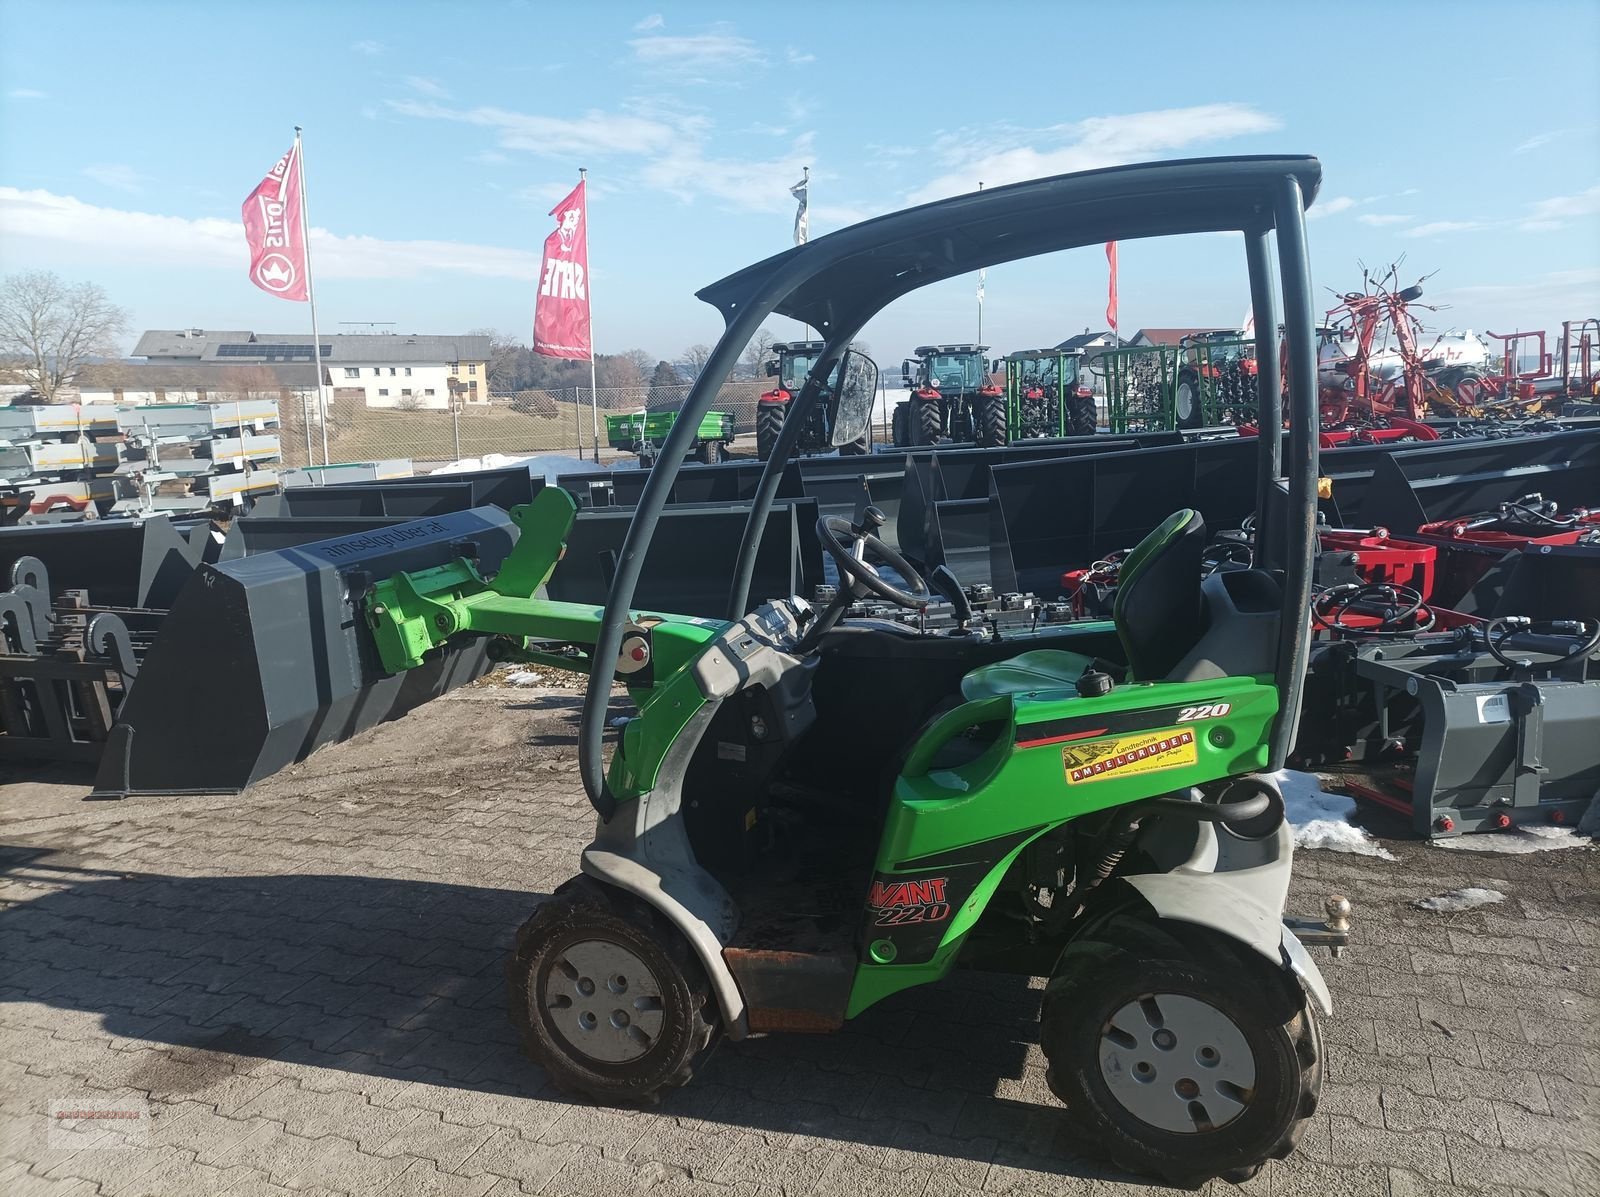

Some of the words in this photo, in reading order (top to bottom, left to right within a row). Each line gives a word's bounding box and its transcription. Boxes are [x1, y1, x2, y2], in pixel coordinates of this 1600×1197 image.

[1422, 346, 1464, 360] Fuchs
[320, 520, 450, 559] amselgruber.at
[1176, 703, 1232, 724] 220
[1072, 733, 1192, 780] AMSELGRUBER
[1116, 736, 1158, 754] Landtechnik
[869, 879, 947, 908] AVANT
[876, 902, 951, 925] 220
